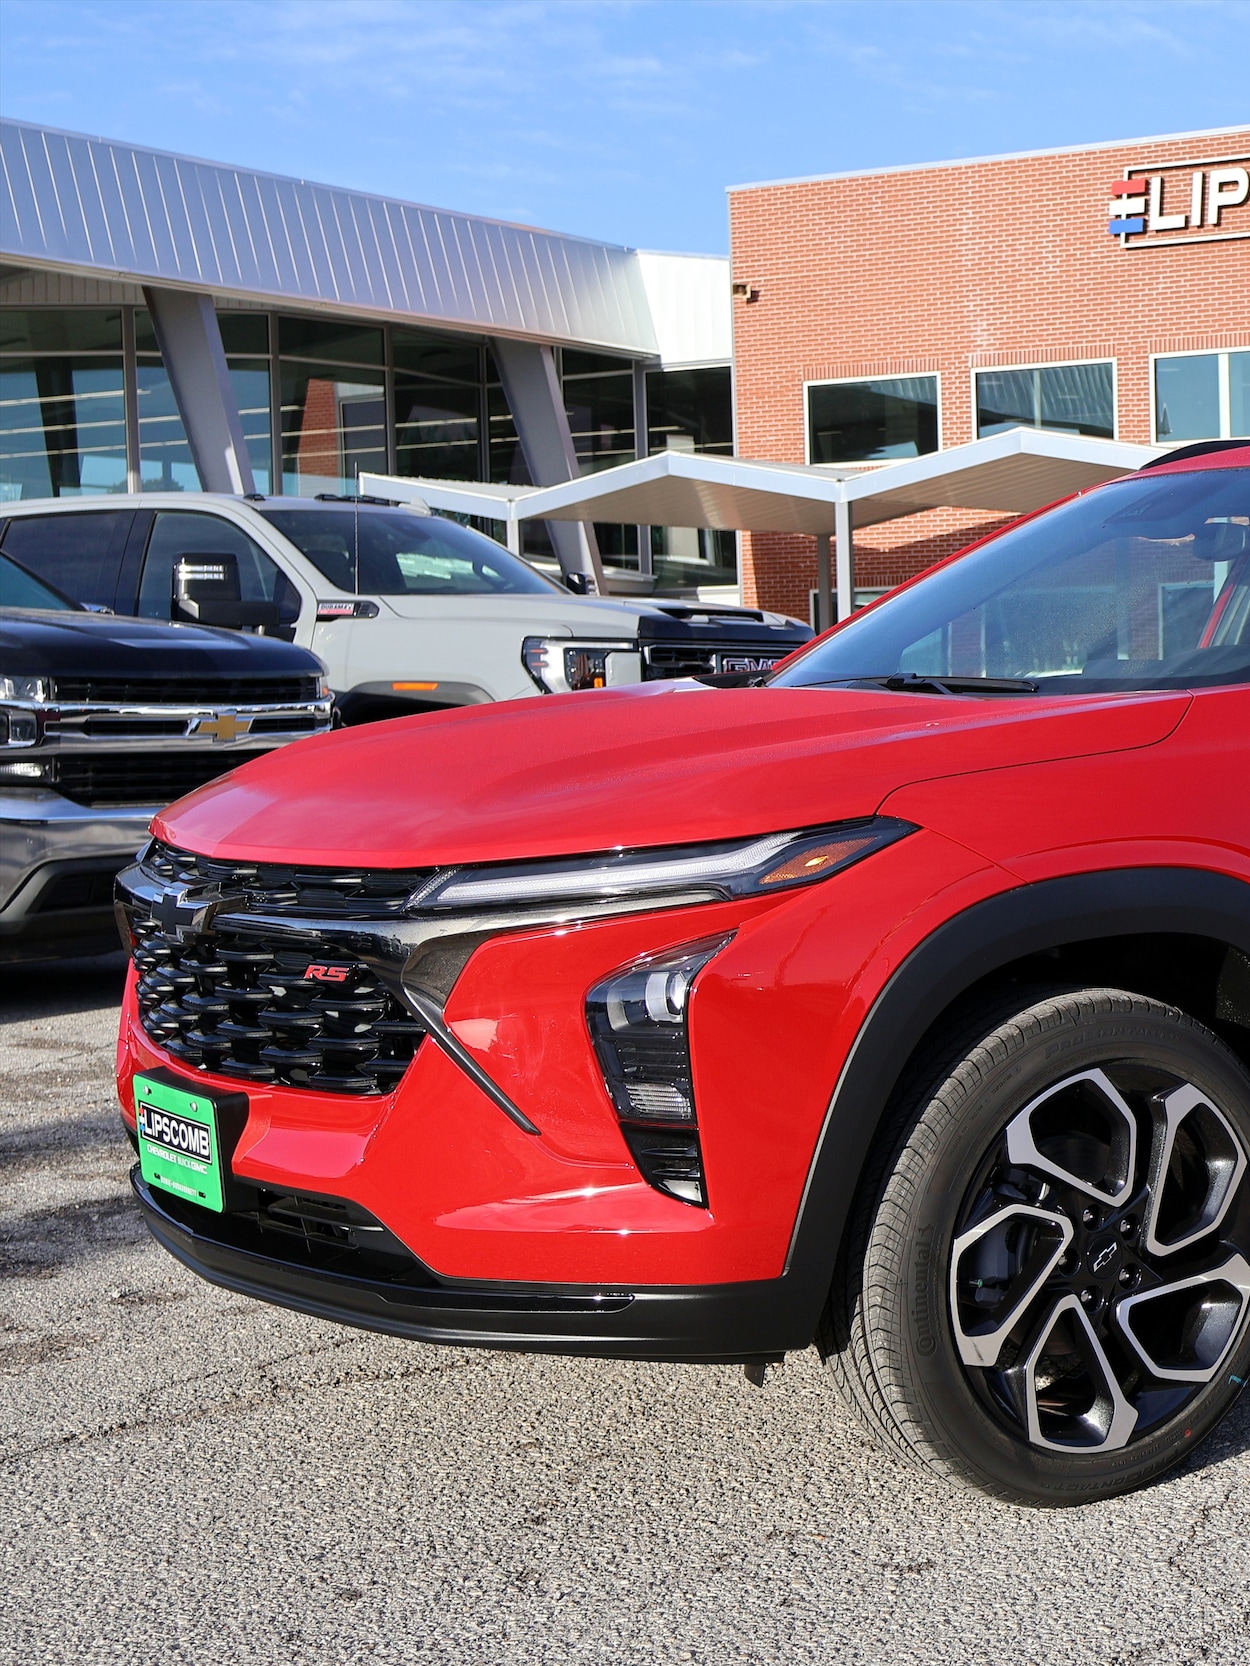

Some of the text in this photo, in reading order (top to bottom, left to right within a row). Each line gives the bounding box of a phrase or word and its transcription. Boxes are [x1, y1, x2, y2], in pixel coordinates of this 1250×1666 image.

[303, 964, 350, 982] RS
[143, 1108, 210, 1157] LIPSCOMB
[146, 1143, 177, 1163] CHEVROLET
[911, 1241, 938, 1357] Continental
